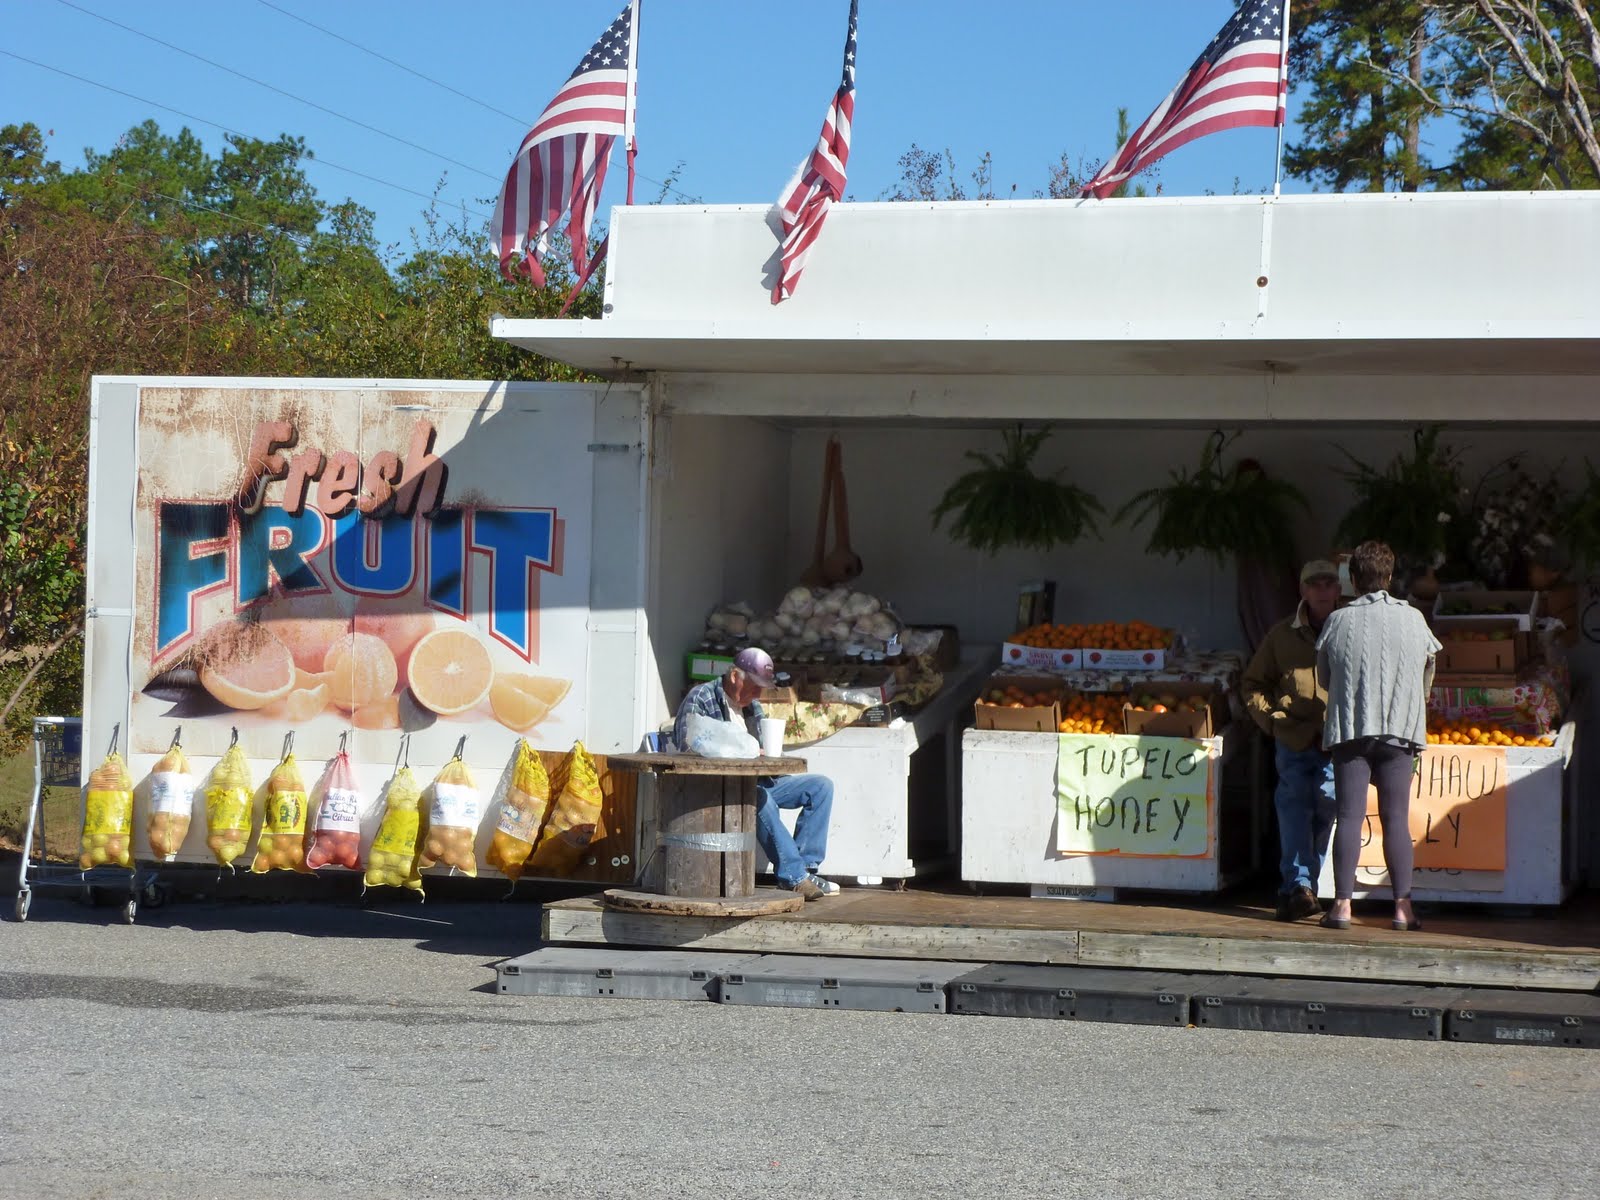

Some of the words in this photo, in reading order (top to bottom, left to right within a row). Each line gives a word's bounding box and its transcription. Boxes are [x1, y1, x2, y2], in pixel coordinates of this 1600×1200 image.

[239, 419, 450, 519] Fresh
[150, 498, 564, 665] FRUIT
[1074, 744, 1198, 779] TUPELO
[1074, 795, 1191, 841] HONEY
